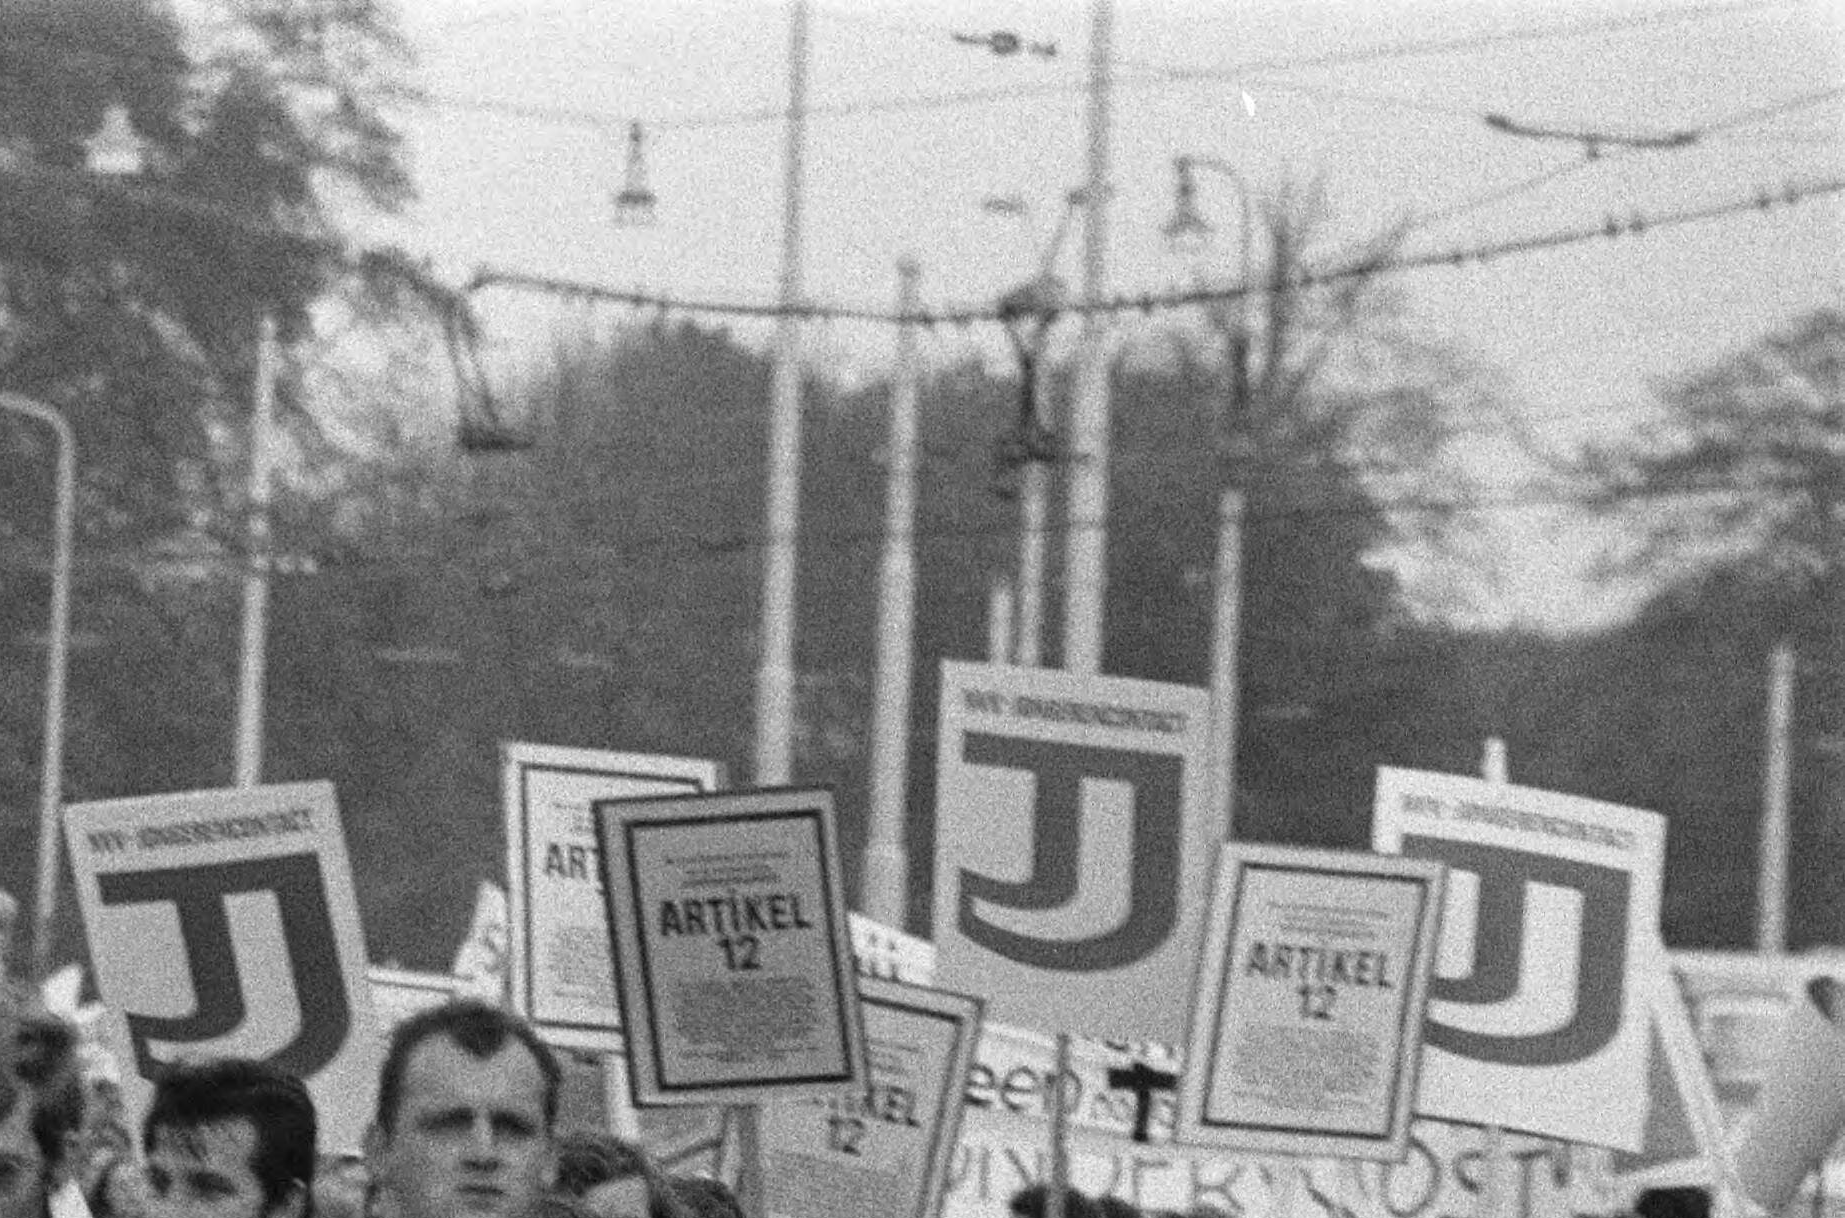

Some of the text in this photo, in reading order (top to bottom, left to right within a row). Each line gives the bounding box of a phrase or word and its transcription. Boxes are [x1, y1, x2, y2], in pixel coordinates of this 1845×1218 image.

[659, 892, 814, 937] ARTIKEL
[717, 937, 762, 972] 12
[1246, 942, 1392, 988] ARTIKEL
[1297, 984, 1337, 1020] 12
[827, 1116, 865, 1158] 12
